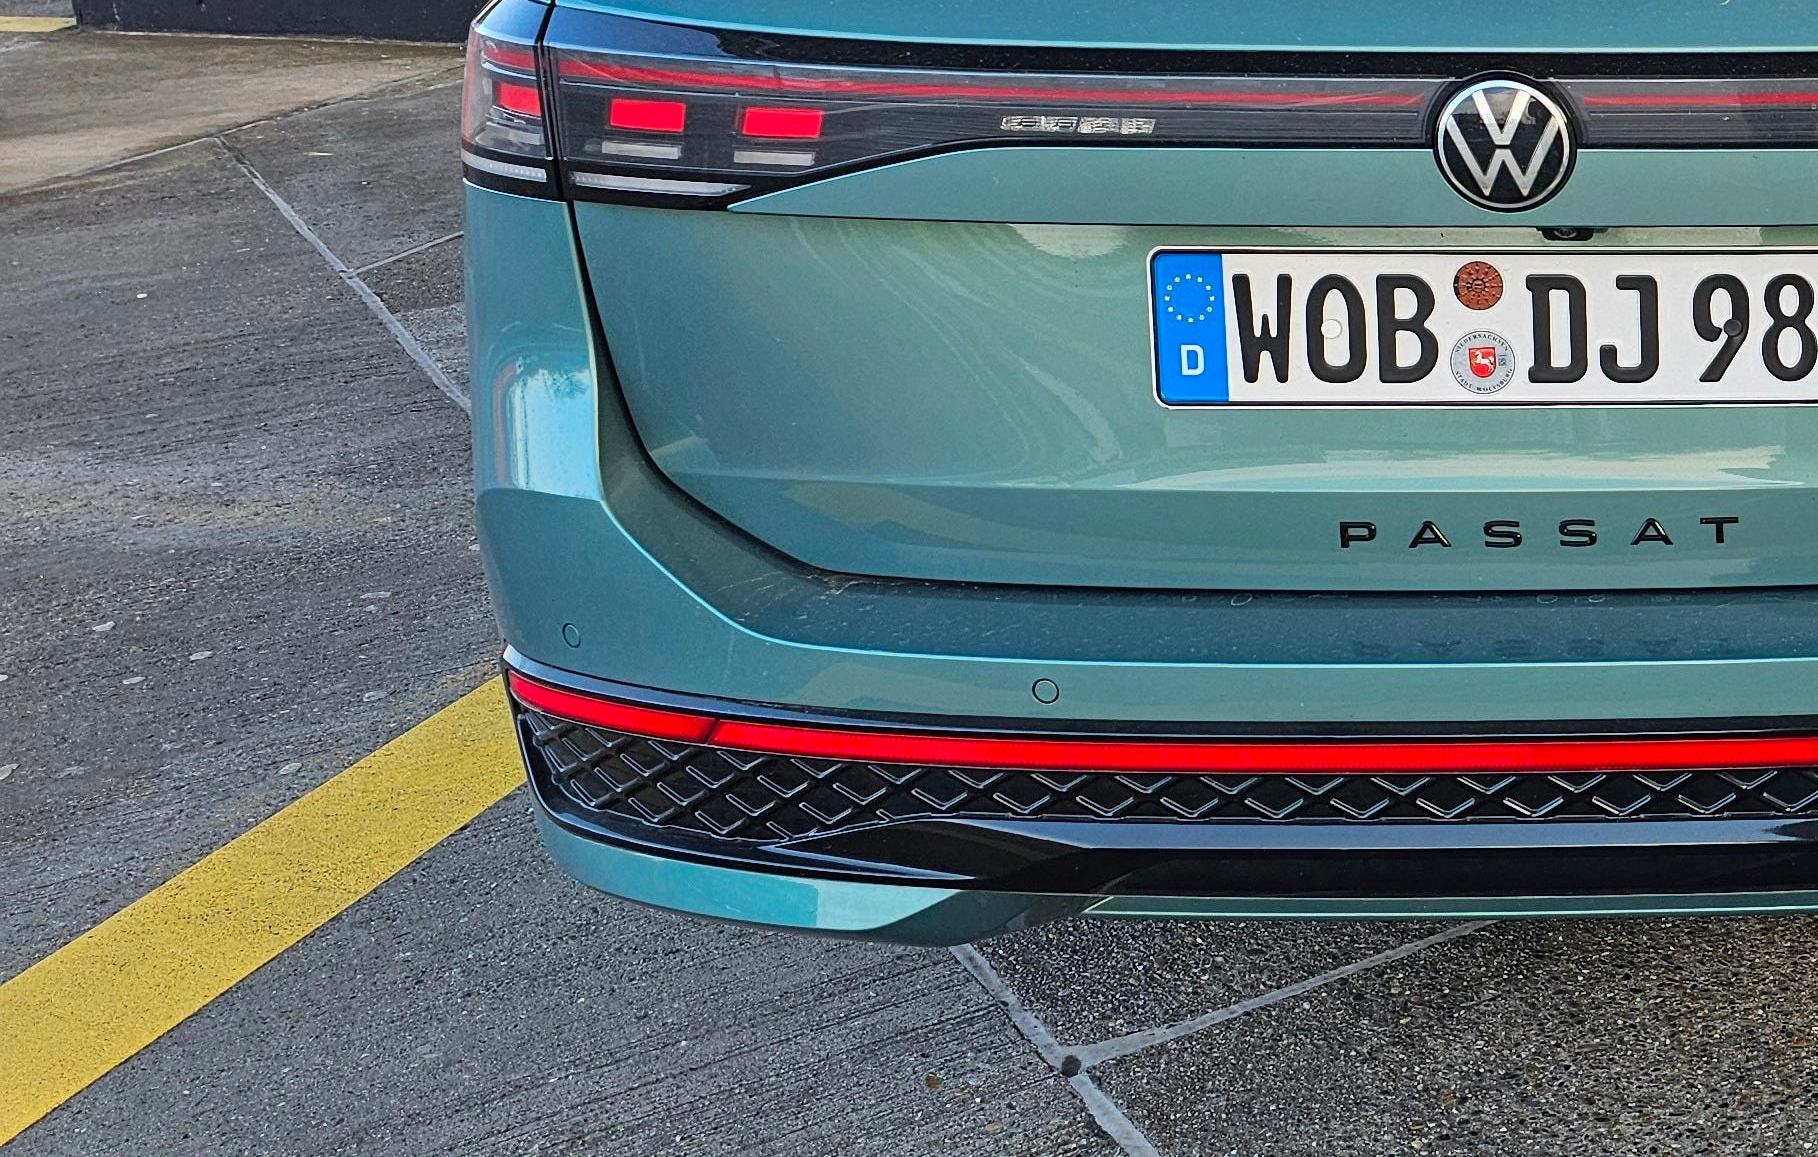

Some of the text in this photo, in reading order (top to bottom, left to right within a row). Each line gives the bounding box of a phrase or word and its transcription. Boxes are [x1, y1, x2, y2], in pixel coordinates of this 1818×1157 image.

[1231, 273, 1440, 384] WOB
[1525, 273, 1660, 384] DJ
[1455, 333, 1509, 353] NIEDERSACHSEN
[1180, 344, 1205, 376] D
[1338, 516, 1740, 549] PASSAT
